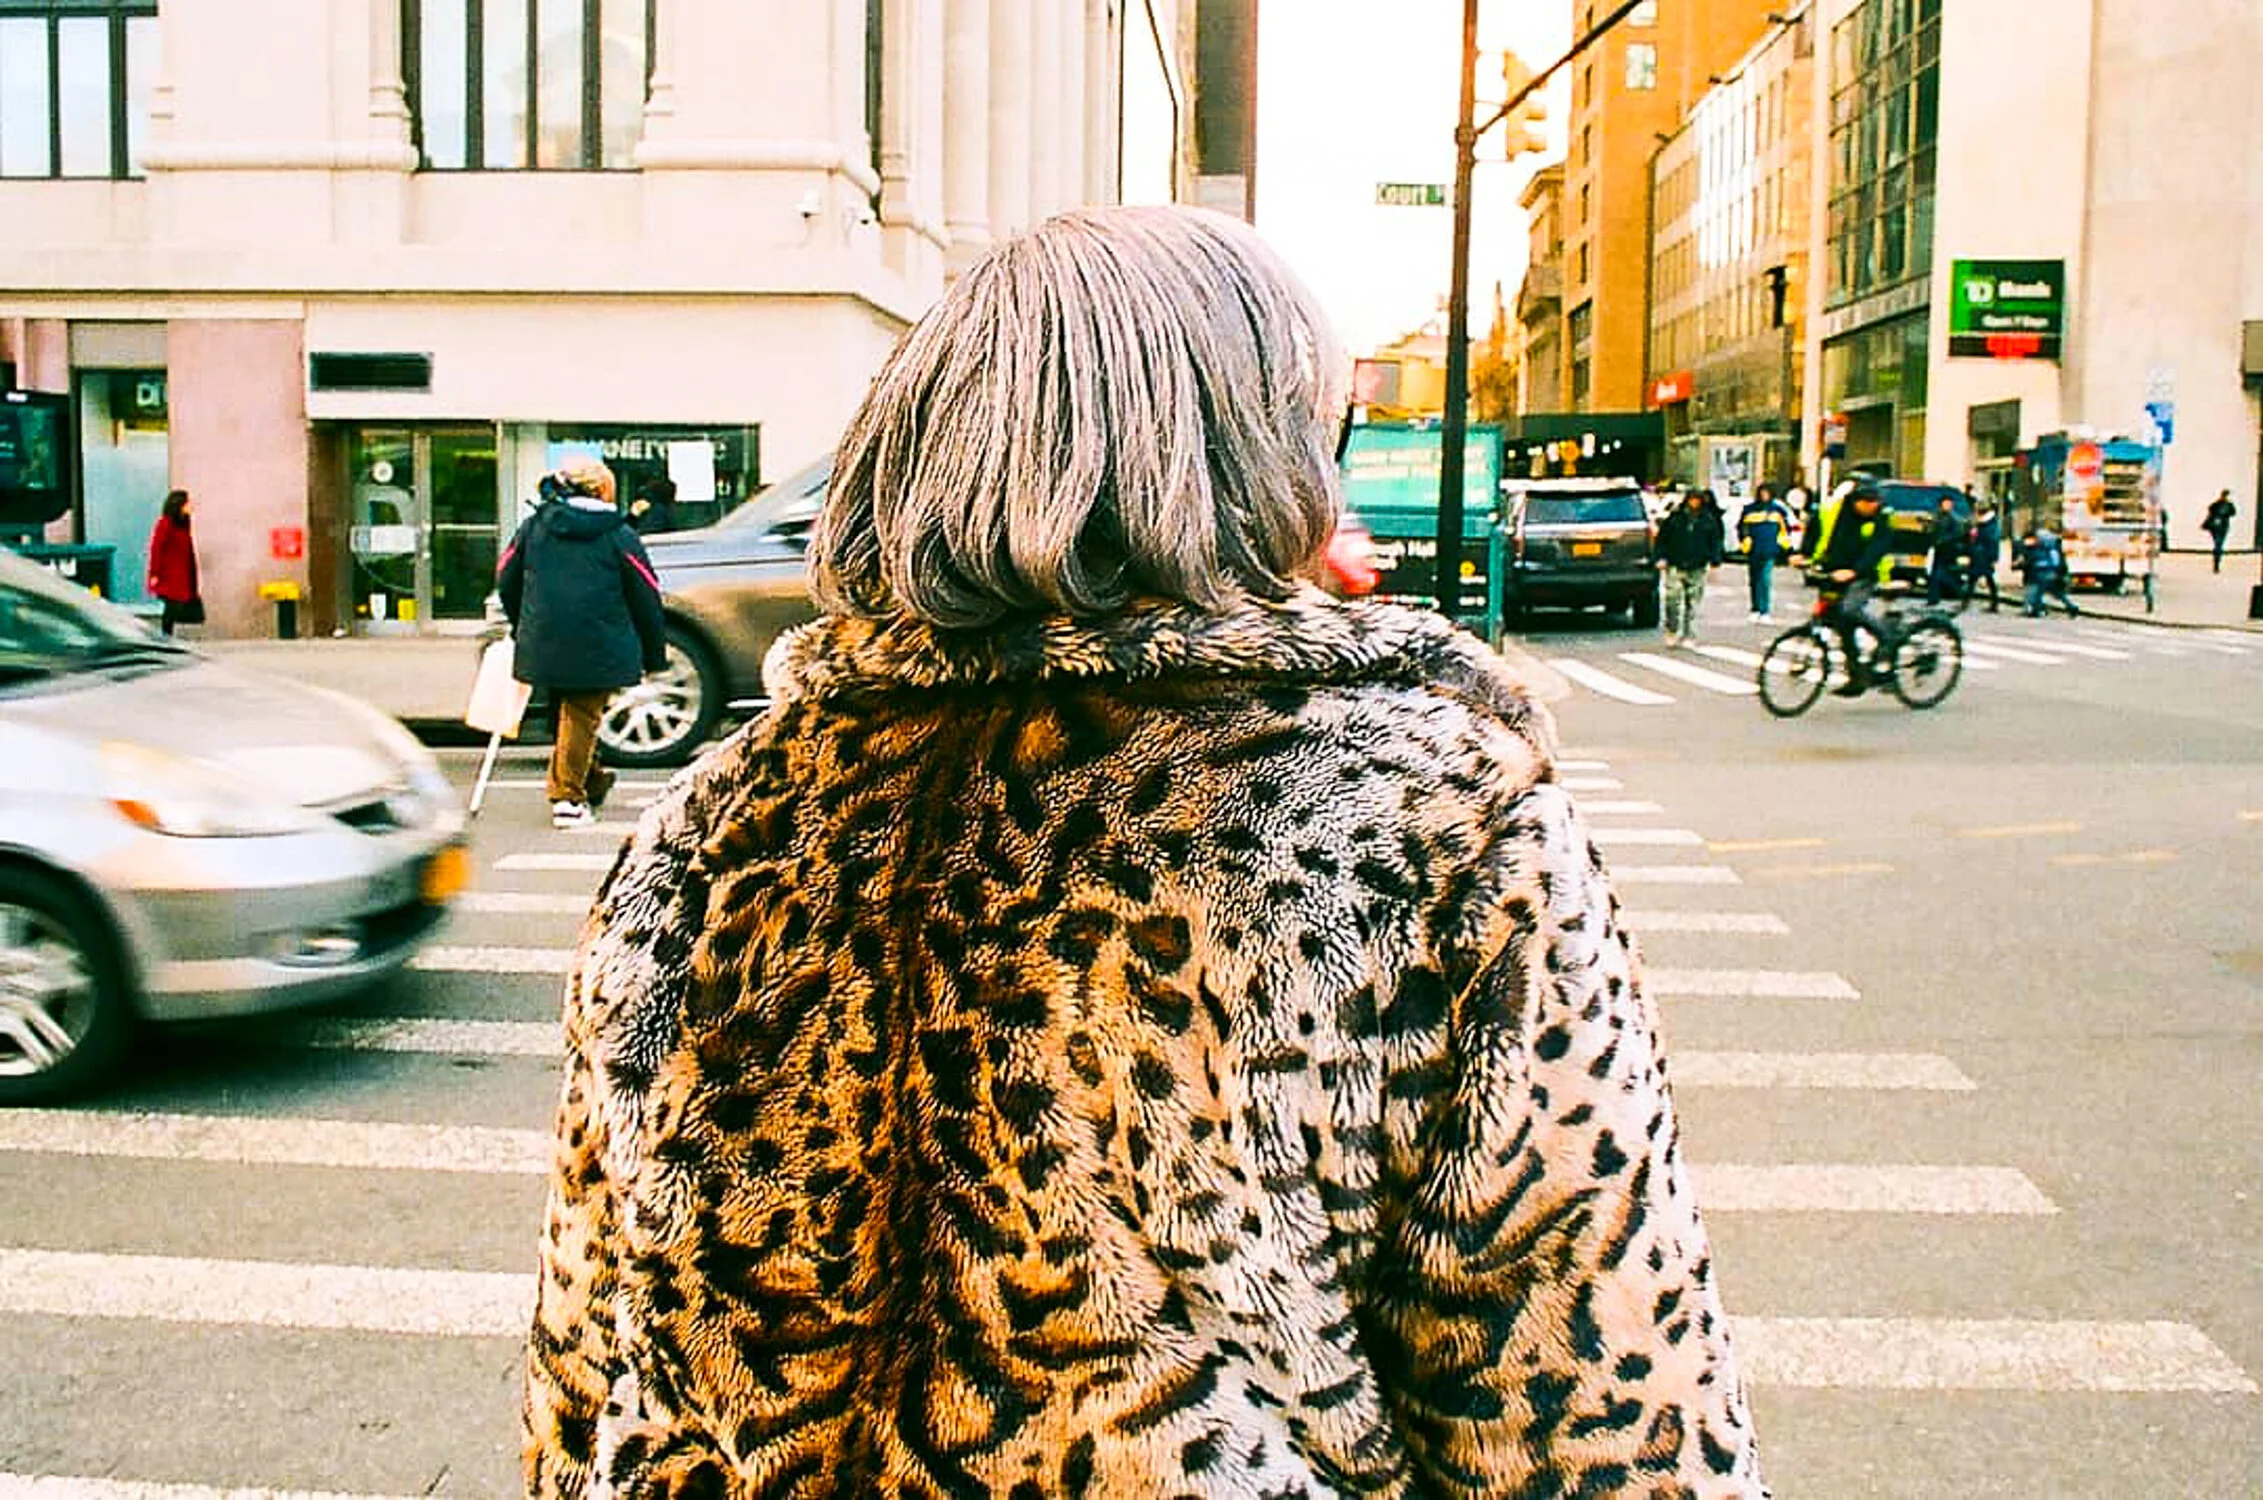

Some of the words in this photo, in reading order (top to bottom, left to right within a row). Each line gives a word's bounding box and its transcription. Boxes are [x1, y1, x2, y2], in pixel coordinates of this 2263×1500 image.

[1378, 183, 1426, 206] Court
[1963, 280, 1994, 302] TD
[1998, 280, 2051, 298] Bank
